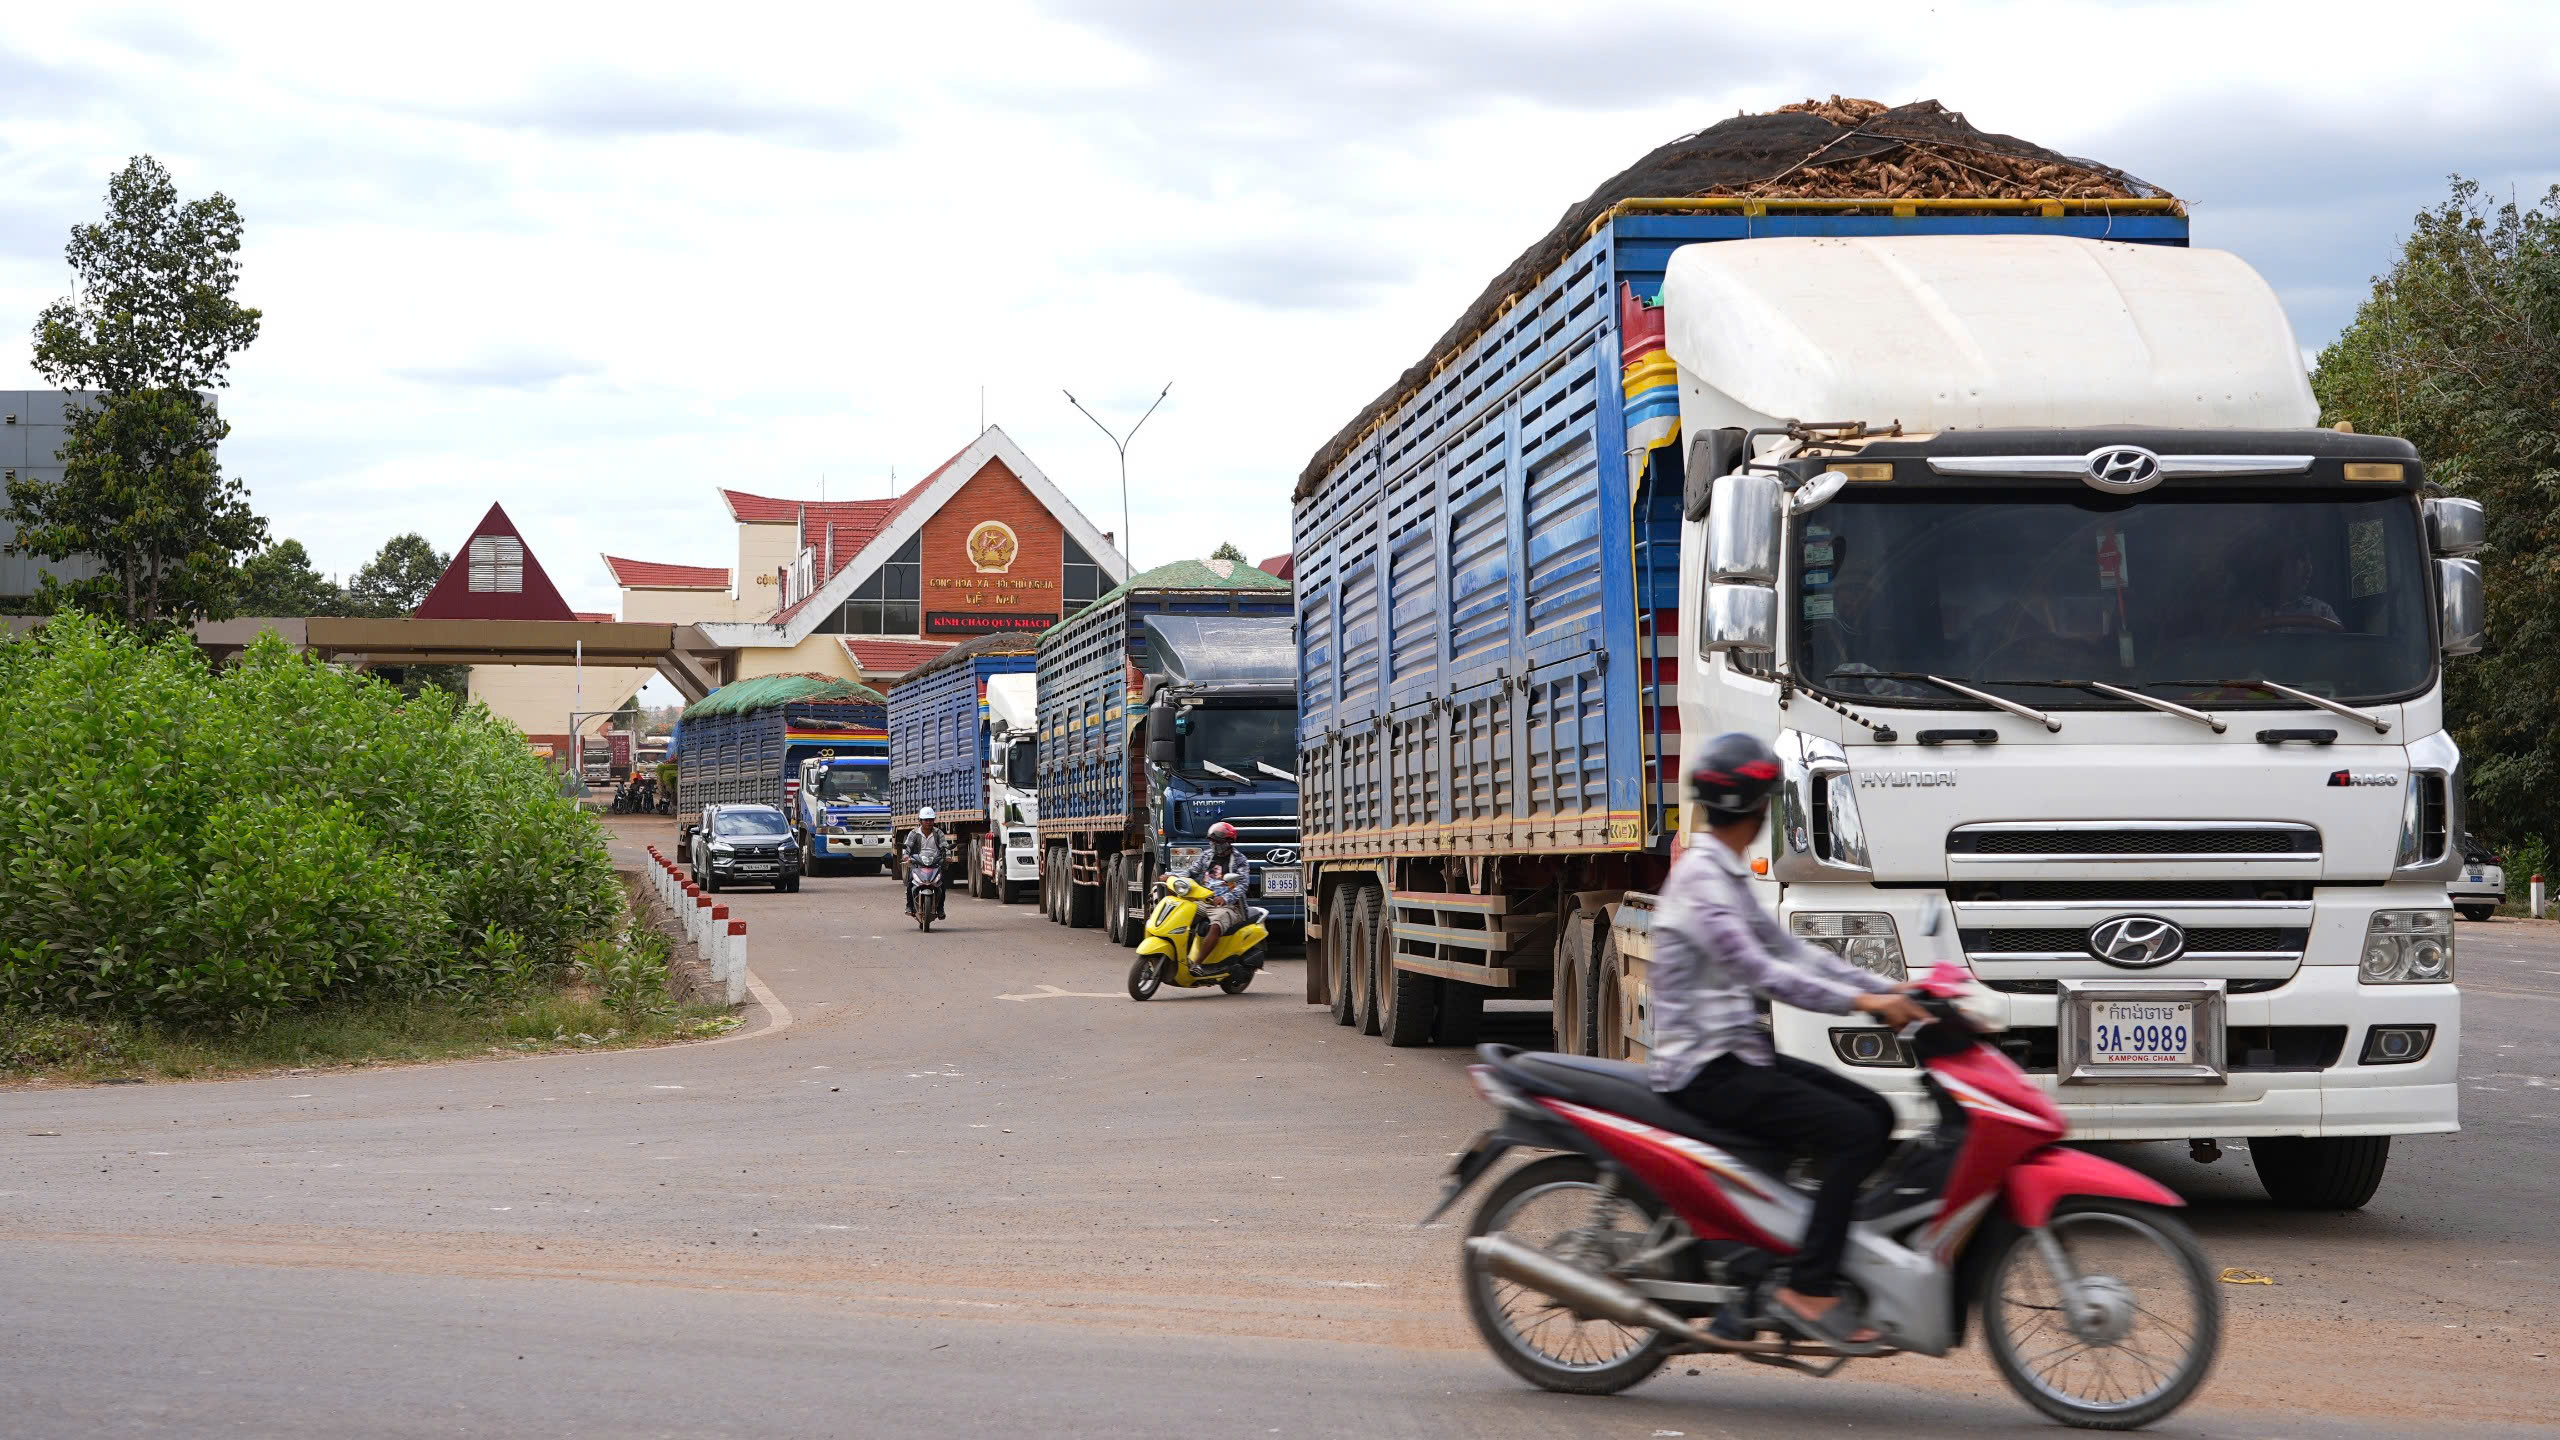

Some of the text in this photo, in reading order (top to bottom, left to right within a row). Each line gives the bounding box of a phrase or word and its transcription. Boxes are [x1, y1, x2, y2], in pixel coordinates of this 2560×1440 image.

[934, 616, 1051, 628] KÍNH CHÀO QUÝ KHÁCH
[1860, 771, 1956, 788] HYUNDAI
[2335, 773, 2398, 787] TRAGO
[2097, 1025, 2187, 1052] 3A-9989
